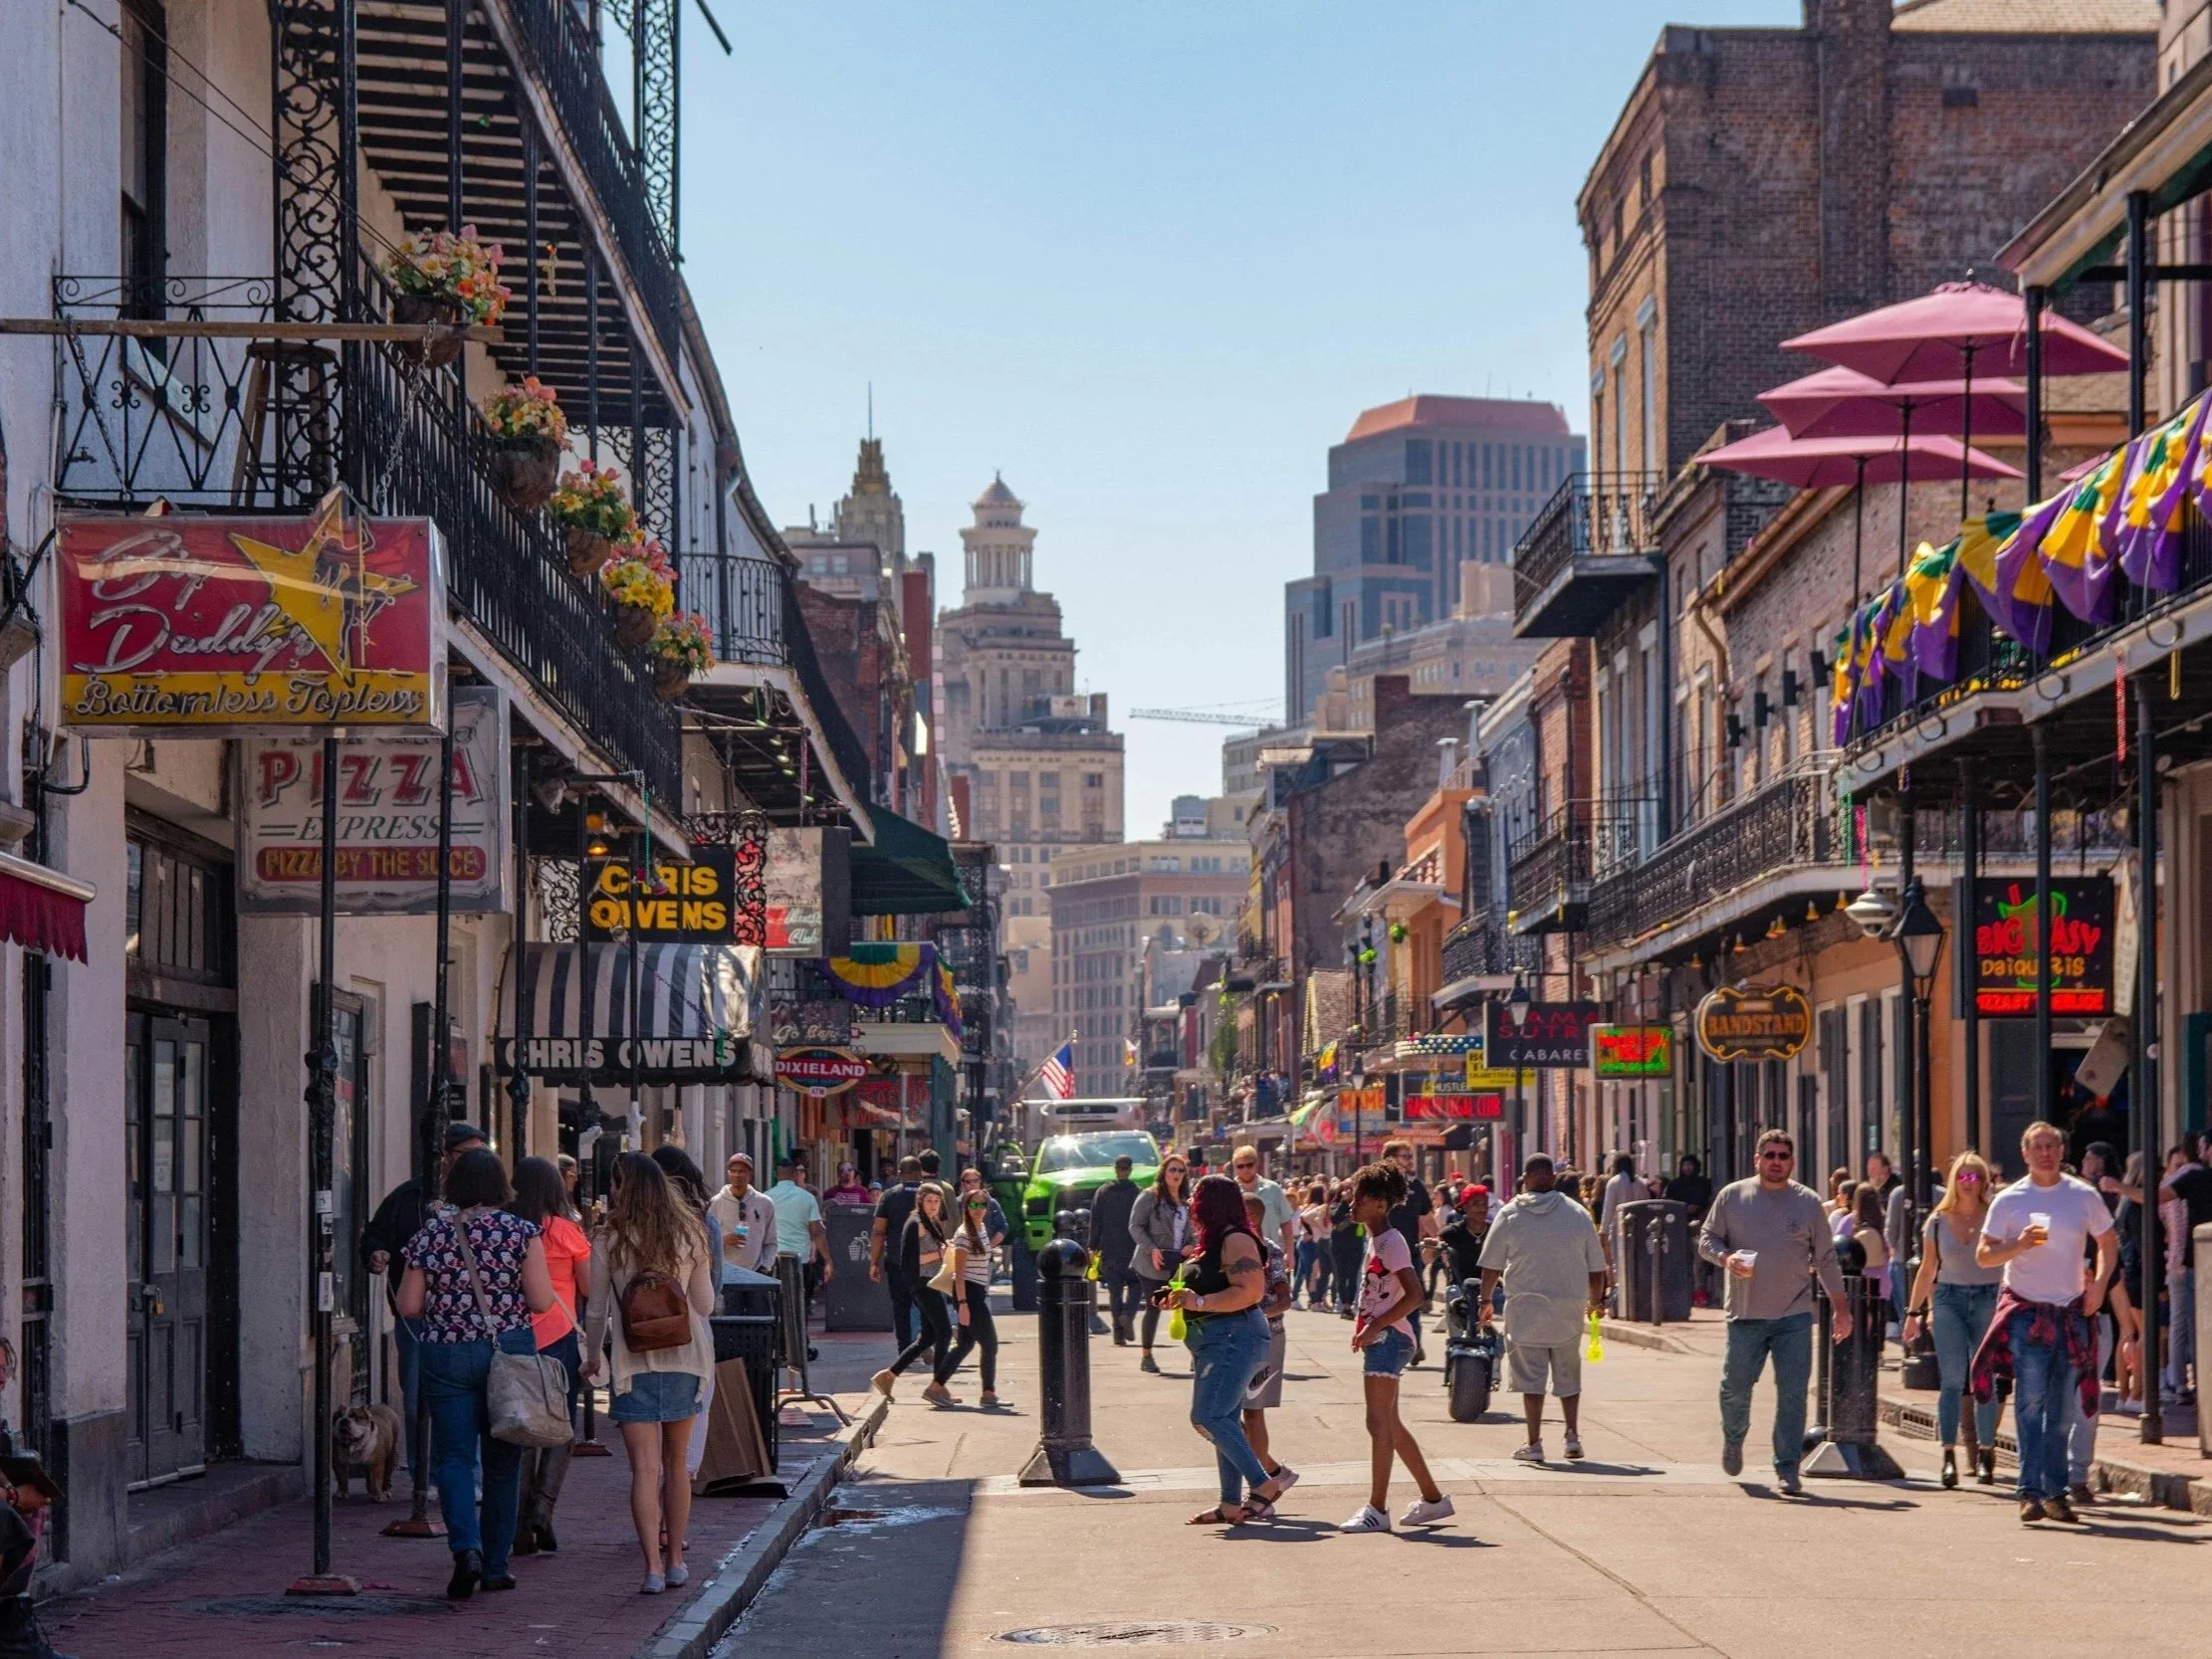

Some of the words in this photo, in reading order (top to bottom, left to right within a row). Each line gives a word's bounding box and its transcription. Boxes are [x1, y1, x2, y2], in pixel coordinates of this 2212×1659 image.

[74, 603, 317, 685] Daddy's
[76, 680, 277, 716] Bottomless
[286, 678, 423, 720] Topless
[257, 747, 485, 809] PIZZA
[265, 849, 323, 878] PIZZA
[334, 850, 362, 877] BY
[372, 850, 411, 877] THE
[417, 849, 480, 877] SLCE
[599, 864, 719, 896] CRIS
[1976, 917, 2025, 955] BIG
[1497, 1025, 1590, 1039] SUTR
[1707, 1013, 1806, 1036] BANDSTAND
[506, 1039, 604, 1069] CHRIS
[618, 1039, 737, 1069] OWENS
[775, 1060, 866, 1076] DIXIELAND
